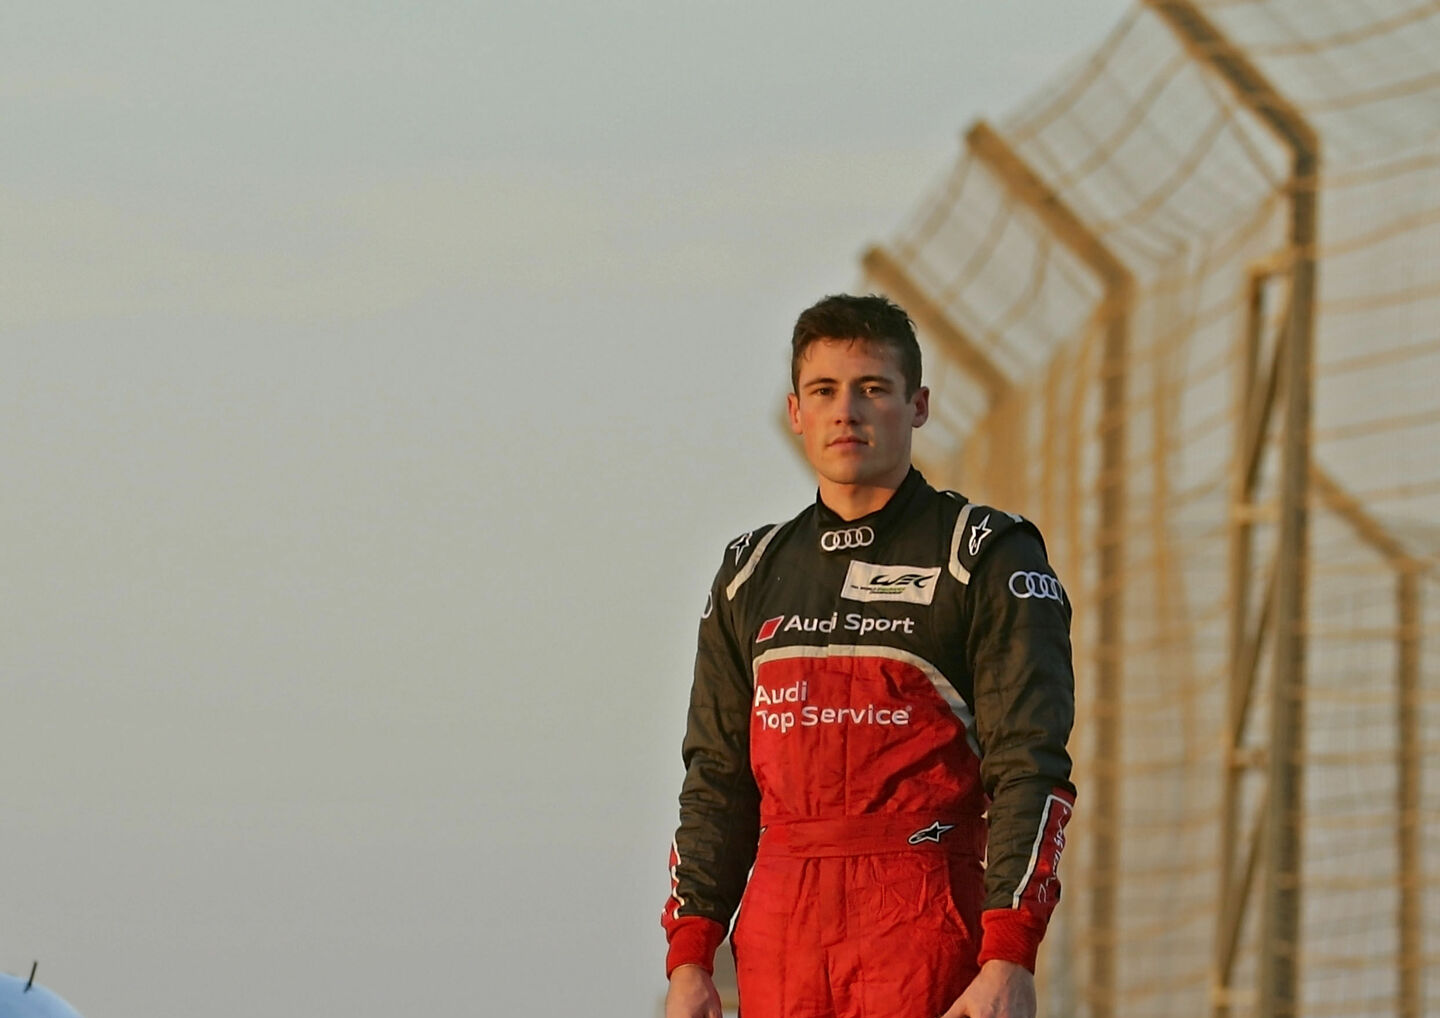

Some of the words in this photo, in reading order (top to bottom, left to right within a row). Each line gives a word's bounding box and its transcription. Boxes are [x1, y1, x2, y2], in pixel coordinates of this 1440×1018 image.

[784, 612, 838, 633] Audi
[844, 613, 915, 635] Sport
[754, 681, 808, 707] Audi
[756, 709, 795, 733] Top
